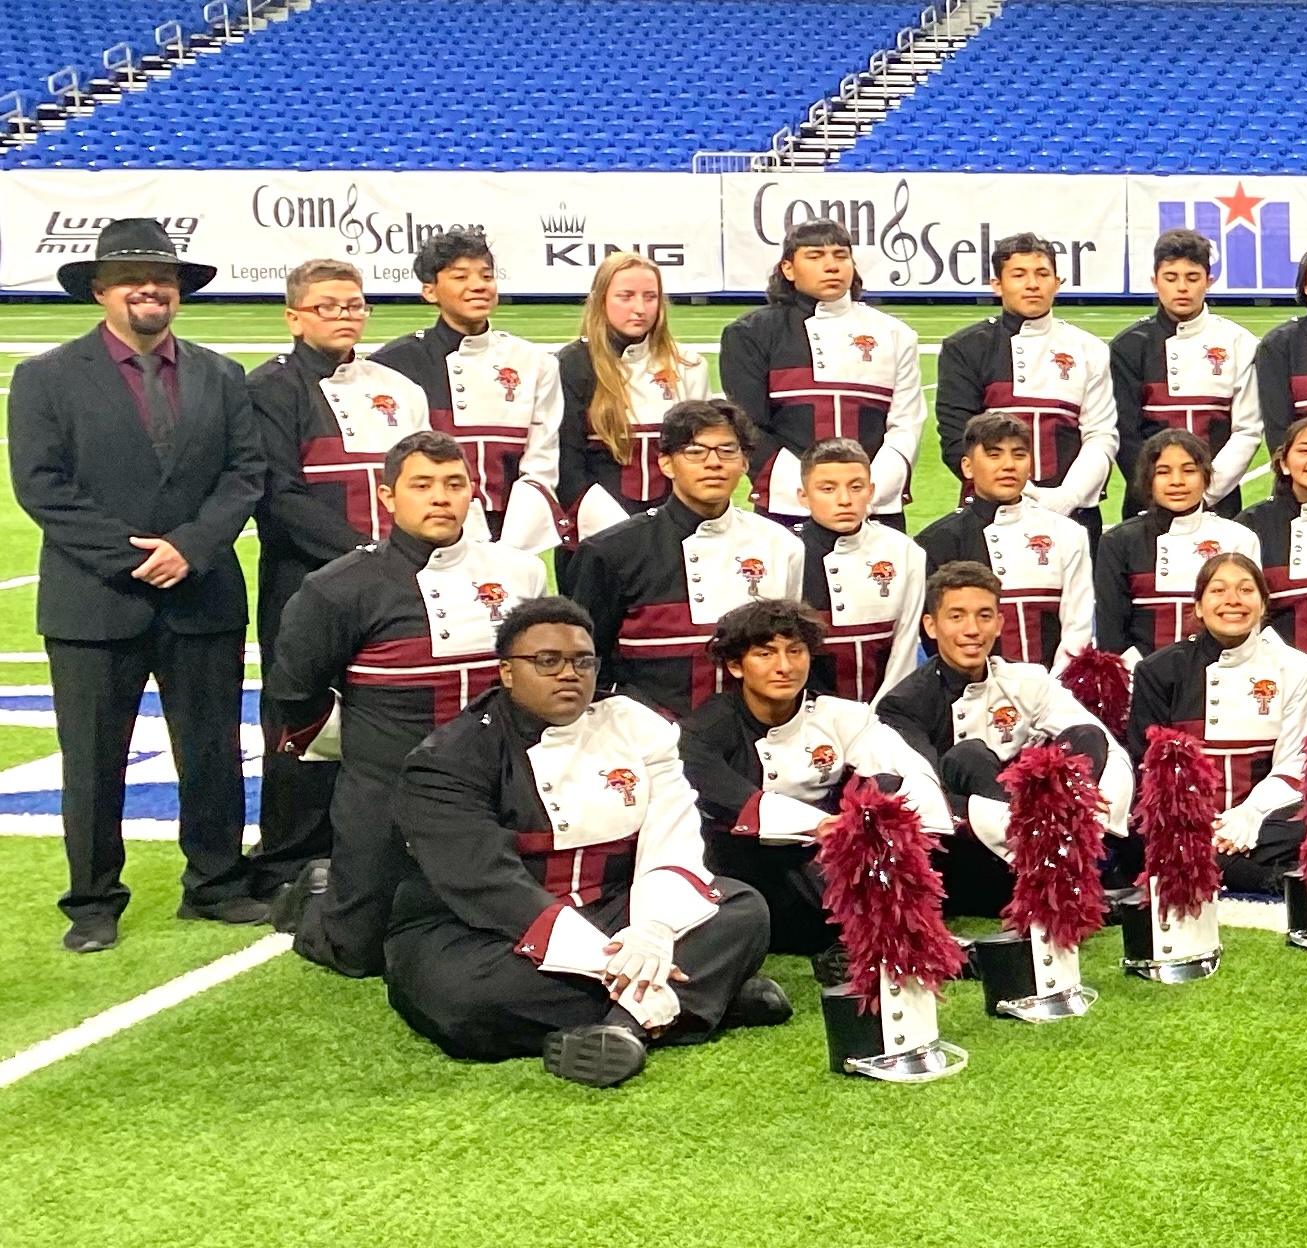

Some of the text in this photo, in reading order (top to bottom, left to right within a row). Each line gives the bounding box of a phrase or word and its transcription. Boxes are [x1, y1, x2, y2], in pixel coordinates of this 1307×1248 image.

[253, 184, 485, 254] Conn Selm
[919, 222, 1097, 287] Selr
